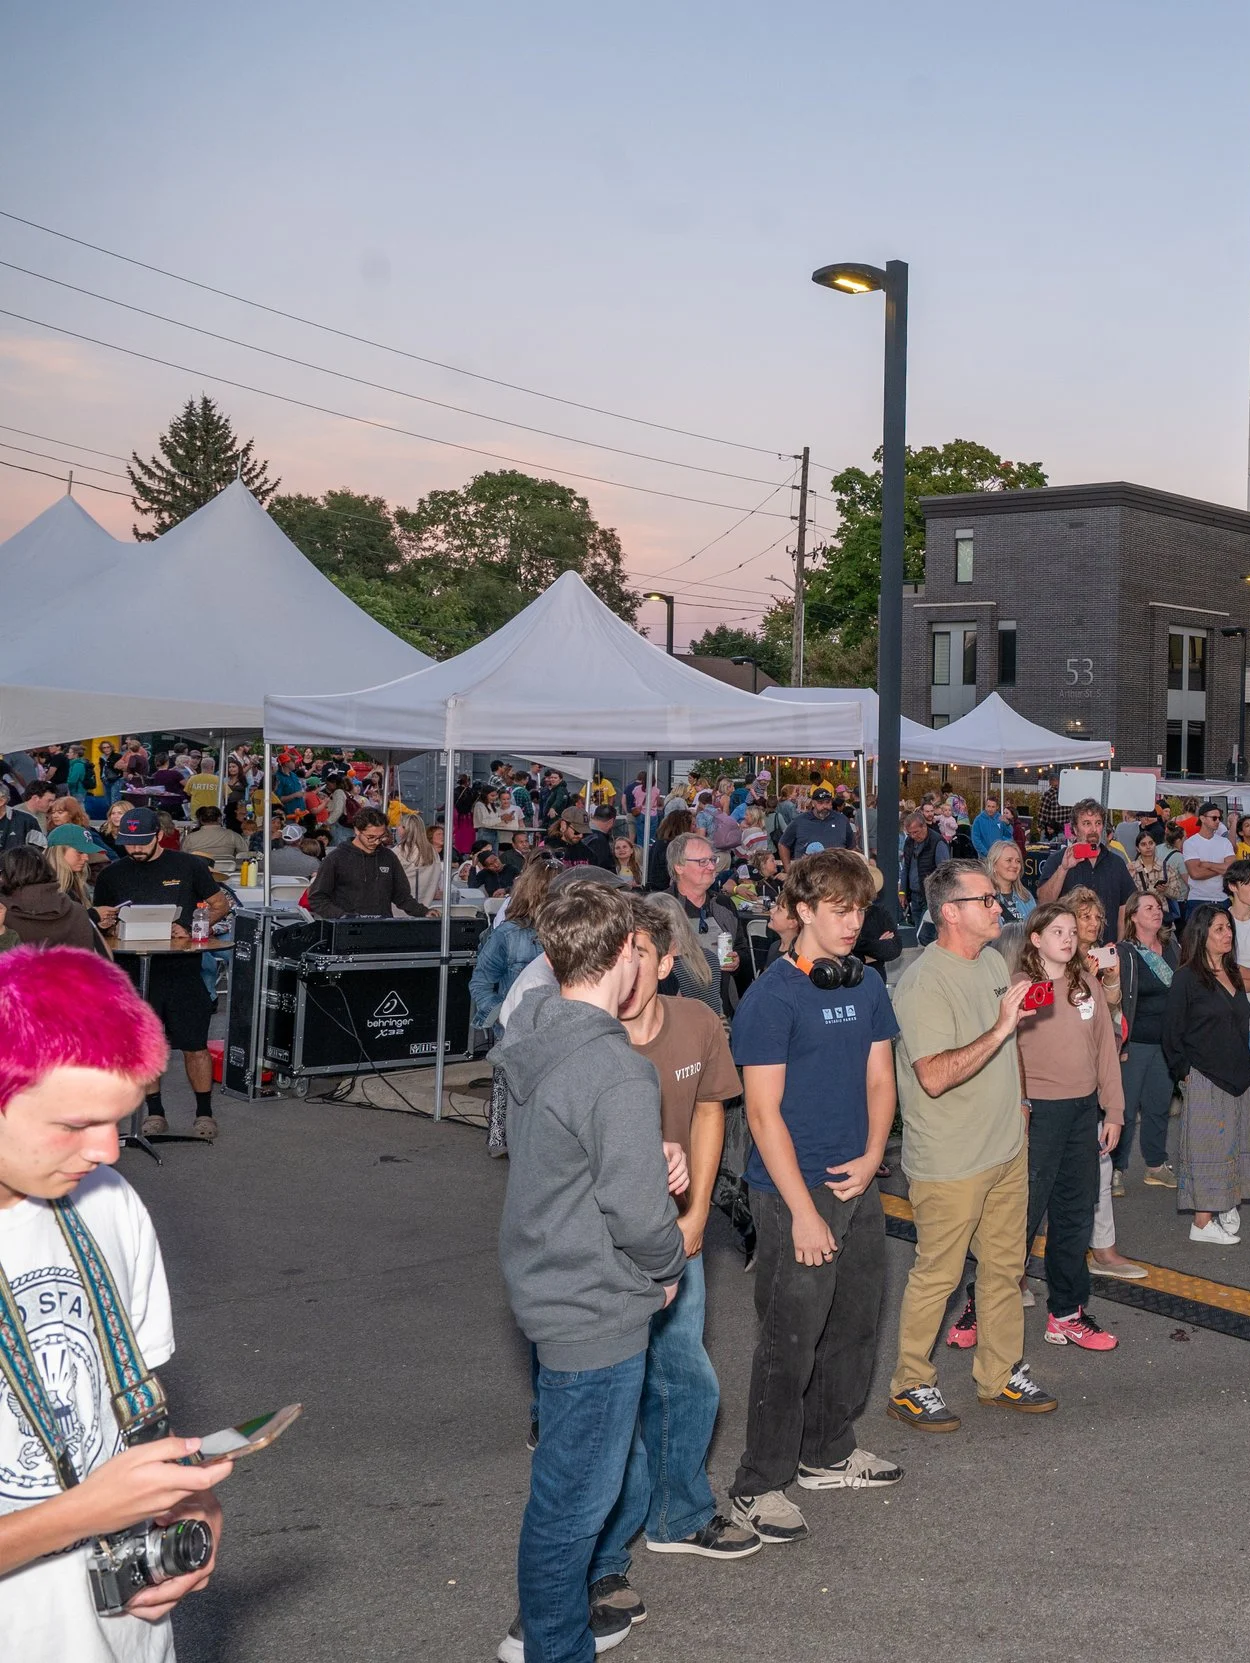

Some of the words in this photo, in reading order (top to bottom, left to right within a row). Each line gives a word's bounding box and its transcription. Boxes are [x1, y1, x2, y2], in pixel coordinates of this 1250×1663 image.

[1066, 658, 1093, 685] 53
[192, 783, 218, 791] ARTIST
[366, 1018, 414, 1028] behringer
[375, 1028, 405, 1040] X32
[38, 1291, 88, 1320] STA
